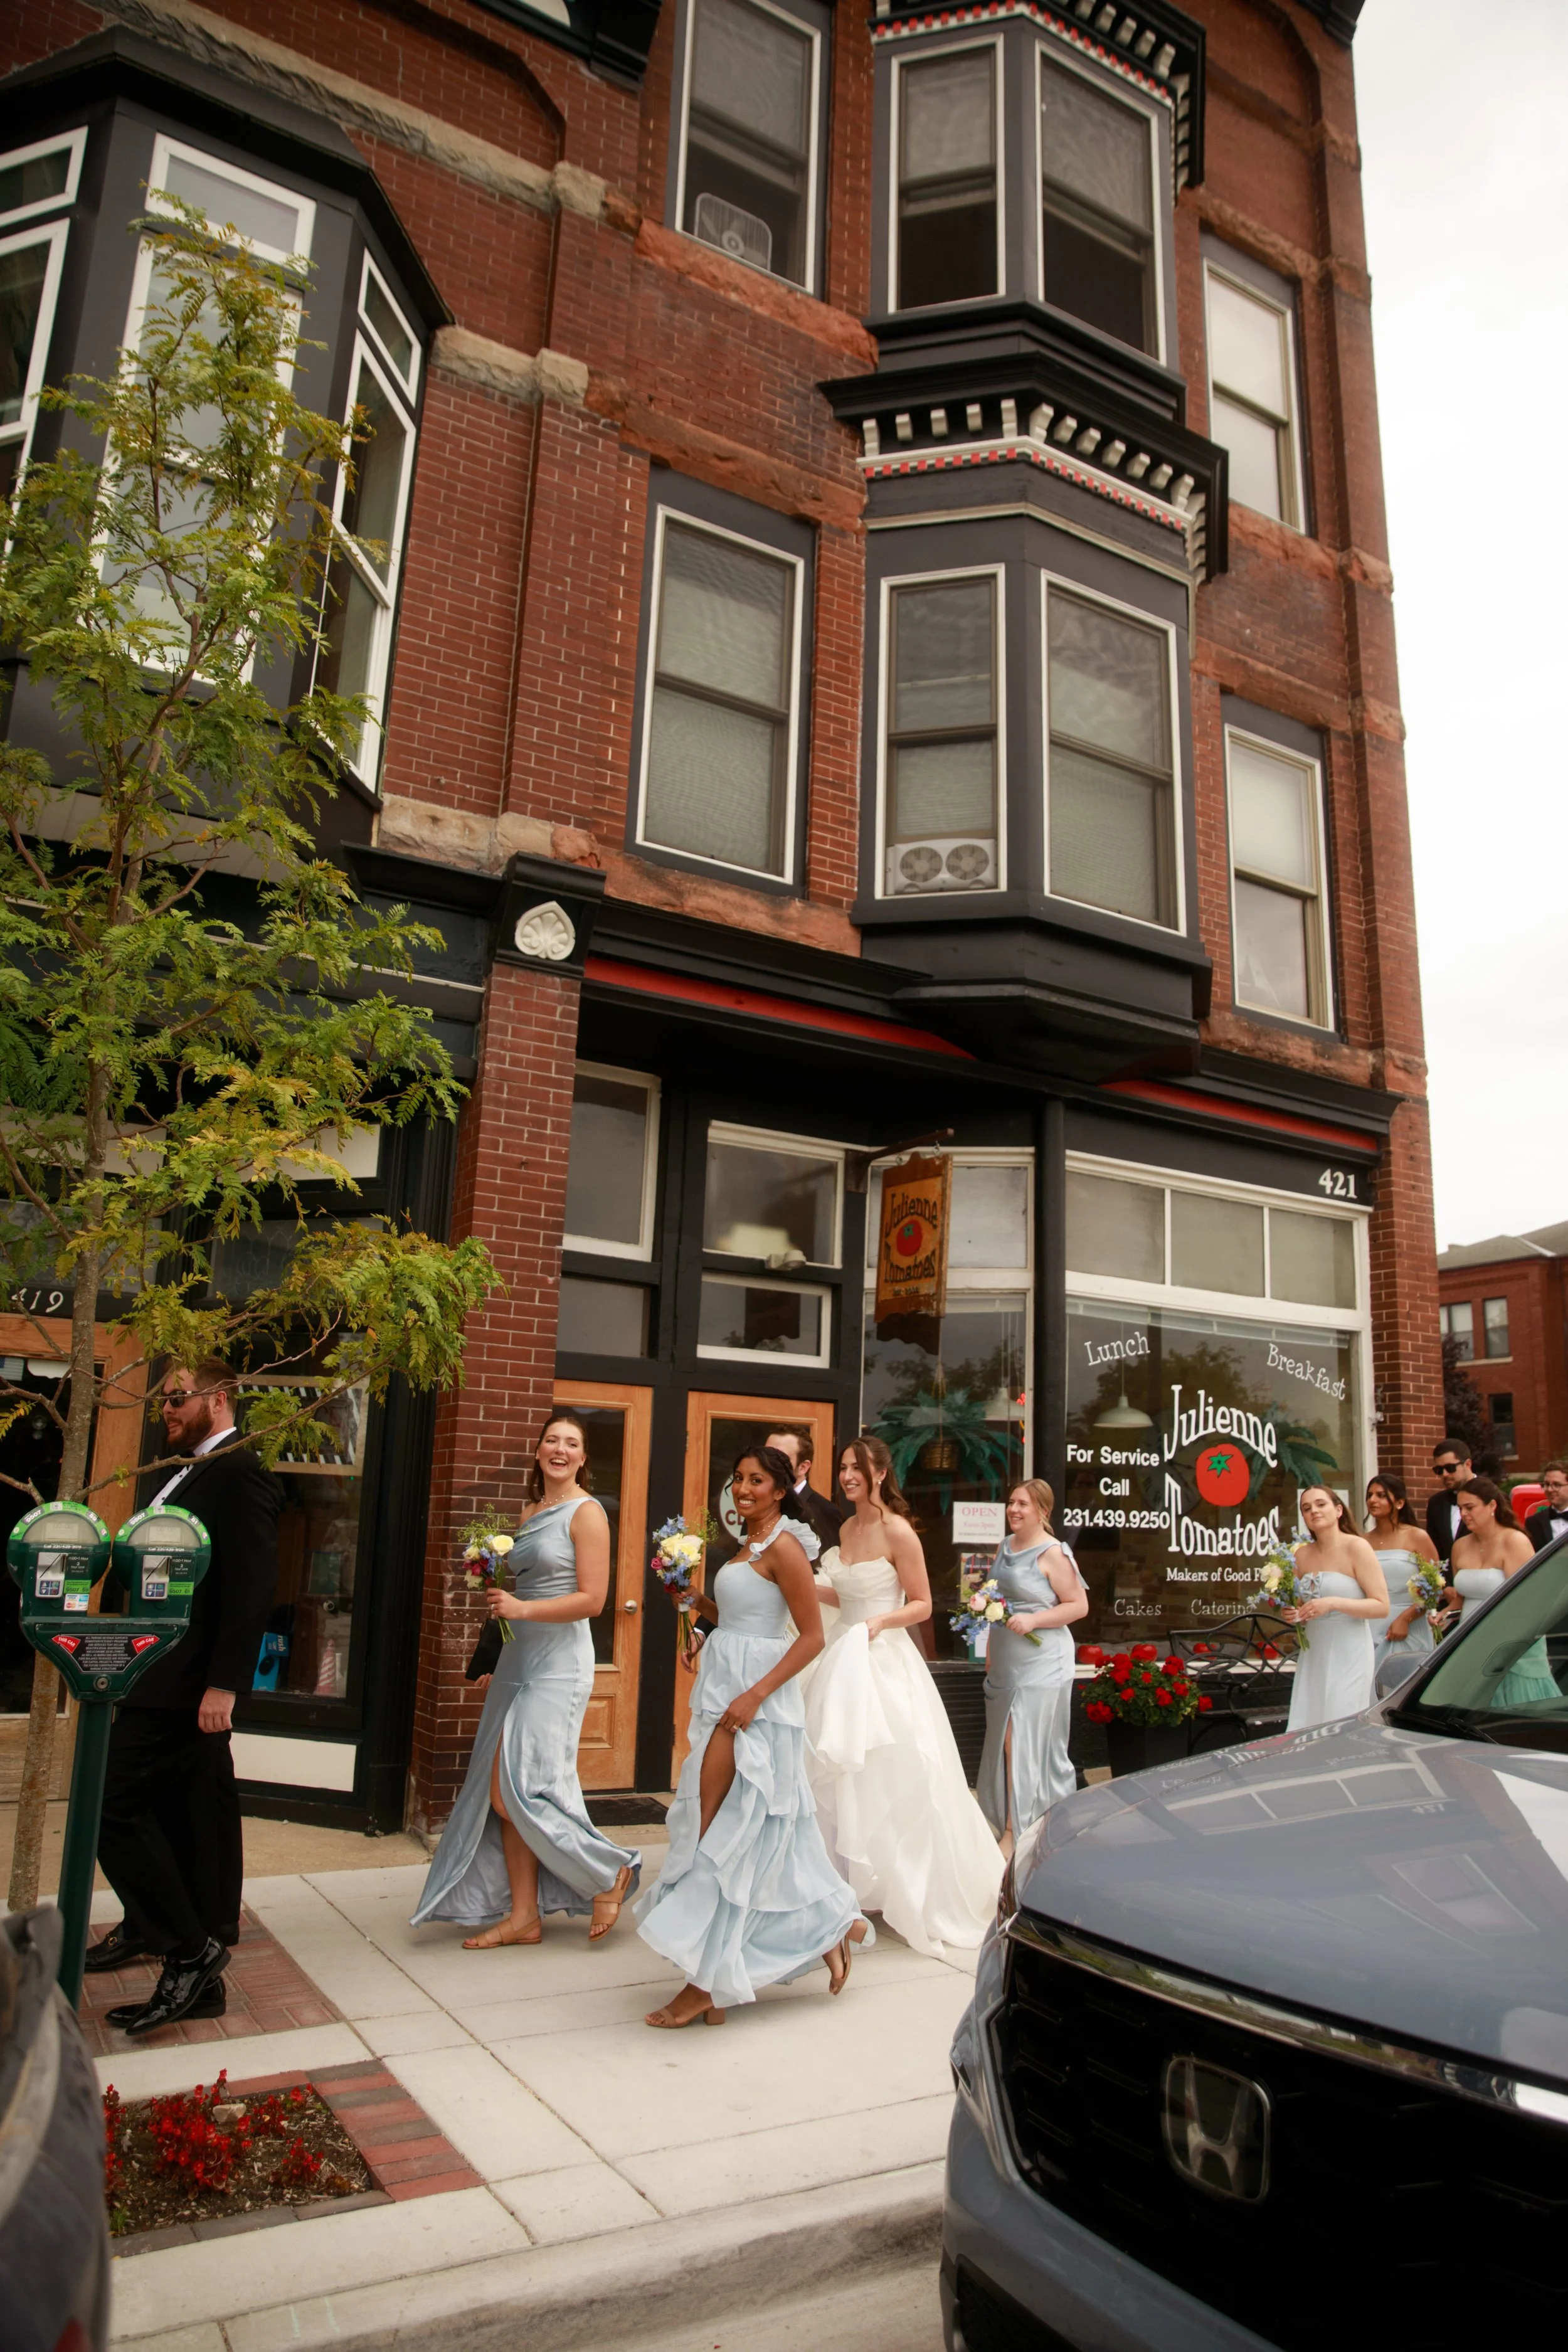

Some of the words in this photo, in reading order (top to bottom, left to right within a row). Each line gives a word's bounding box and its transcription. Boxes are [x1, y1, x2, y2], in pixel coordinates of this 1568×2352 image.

[1318, 1169, 1357, 1200] 421
[885, 1192, 937, 1238] Julienne
[1084, 1331, 1150, 1367] Lunch
[1266, 1343, 1346, 1401] Breakfast
[1163, 1384, 1278, 1468] Julienne
[1067, 1444, 1094, 1463] For
[1100, 1445, 1160, 1466] Service
[1099, 1477, 1130, 1496] Call
[26, 1510, 41, 1522] 9507
[961, 1507, 997, 1517] OPEN
[1063, 1508, 1169, 1528] 231.439.9250
[1164, 1473, 1279, 1557] Tomatoes
[1166, 1567, 1209, 1582] Makers
[1210, 1567, 1222, 1582] of
[1224, 1567, 1252, 1582] Good
[1113, 1598, 1162, 1617] Cakes
